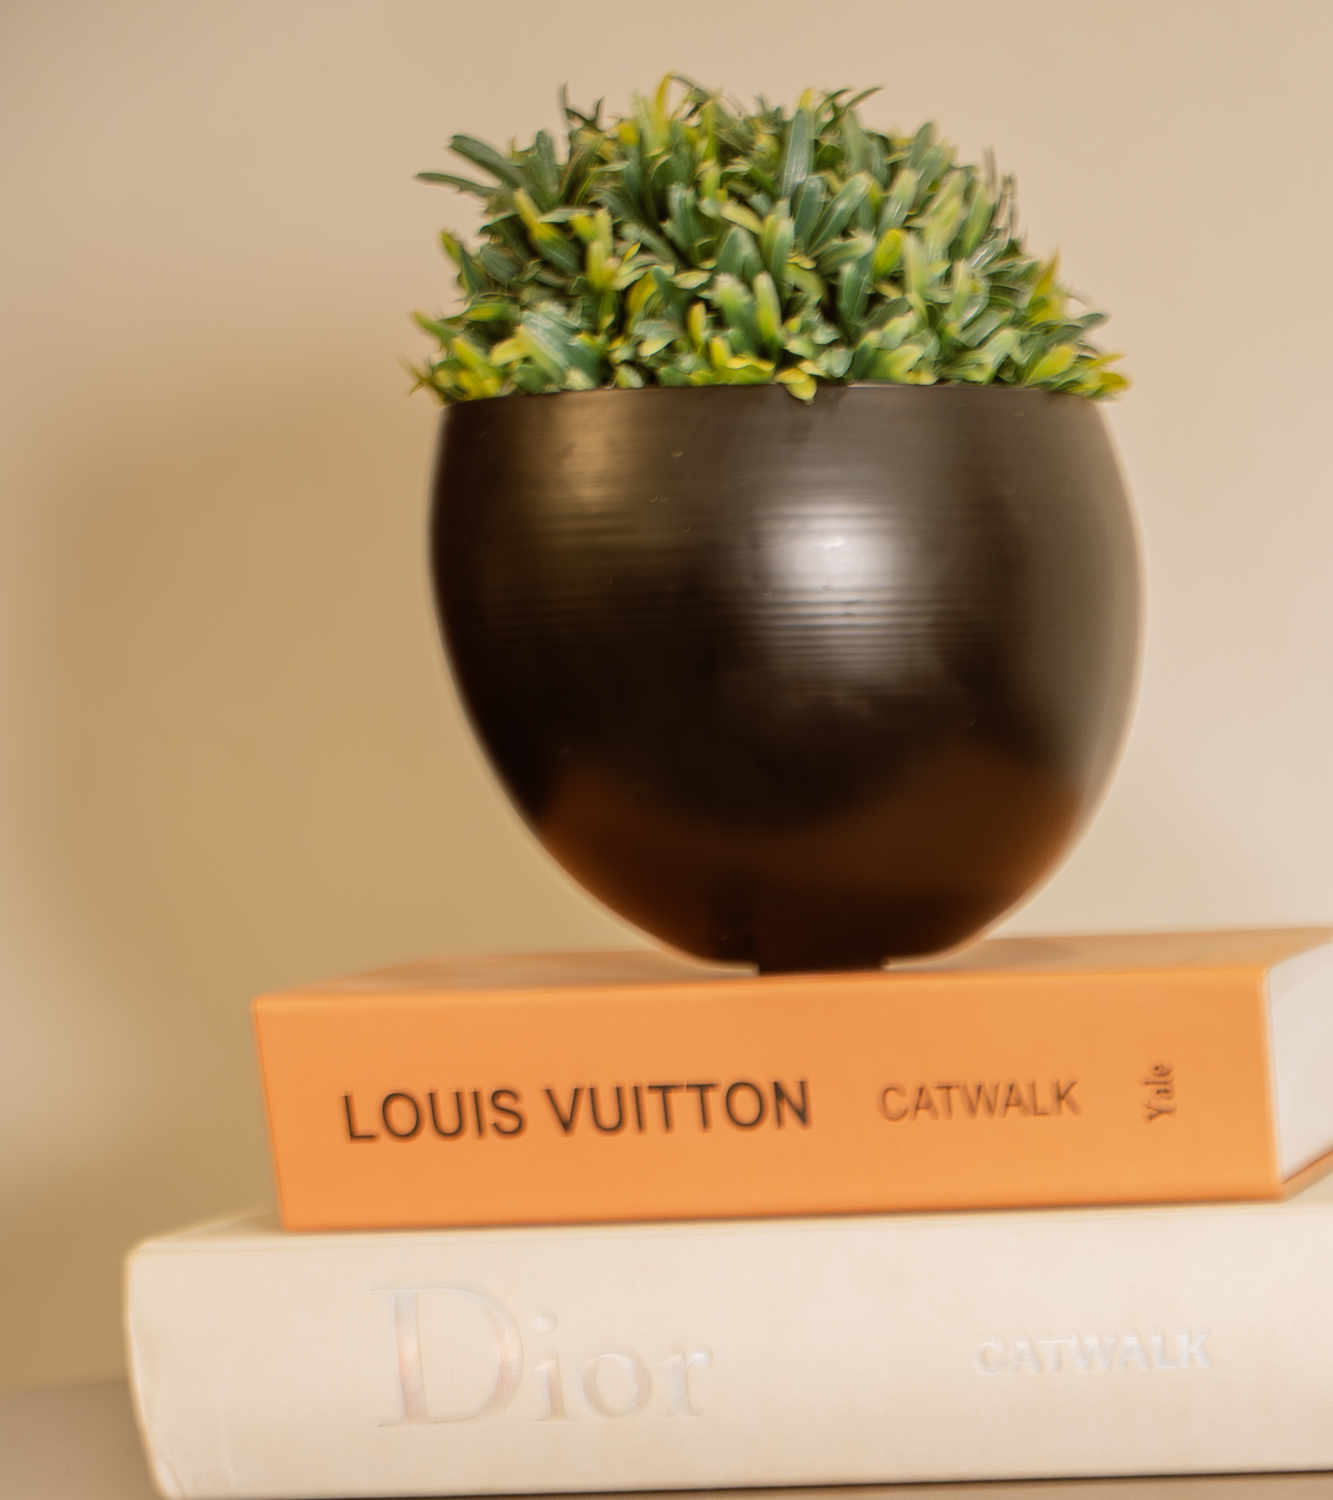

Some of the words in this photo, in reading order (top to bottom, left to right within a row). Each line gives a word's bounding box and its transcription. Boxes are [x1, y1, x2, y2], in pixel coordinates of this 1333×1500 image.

[342, 1087, 526, 1143] LOUIS
[543, 1077, 811, 1137] VUITTON
[877, 1078, 1082, 1122] CATWALK
[1139, 1060, 1176, 1124] Yale
[368, 1281, 714, 1428] Dior
[972, 1325, 1214, 1376] CATWALK
